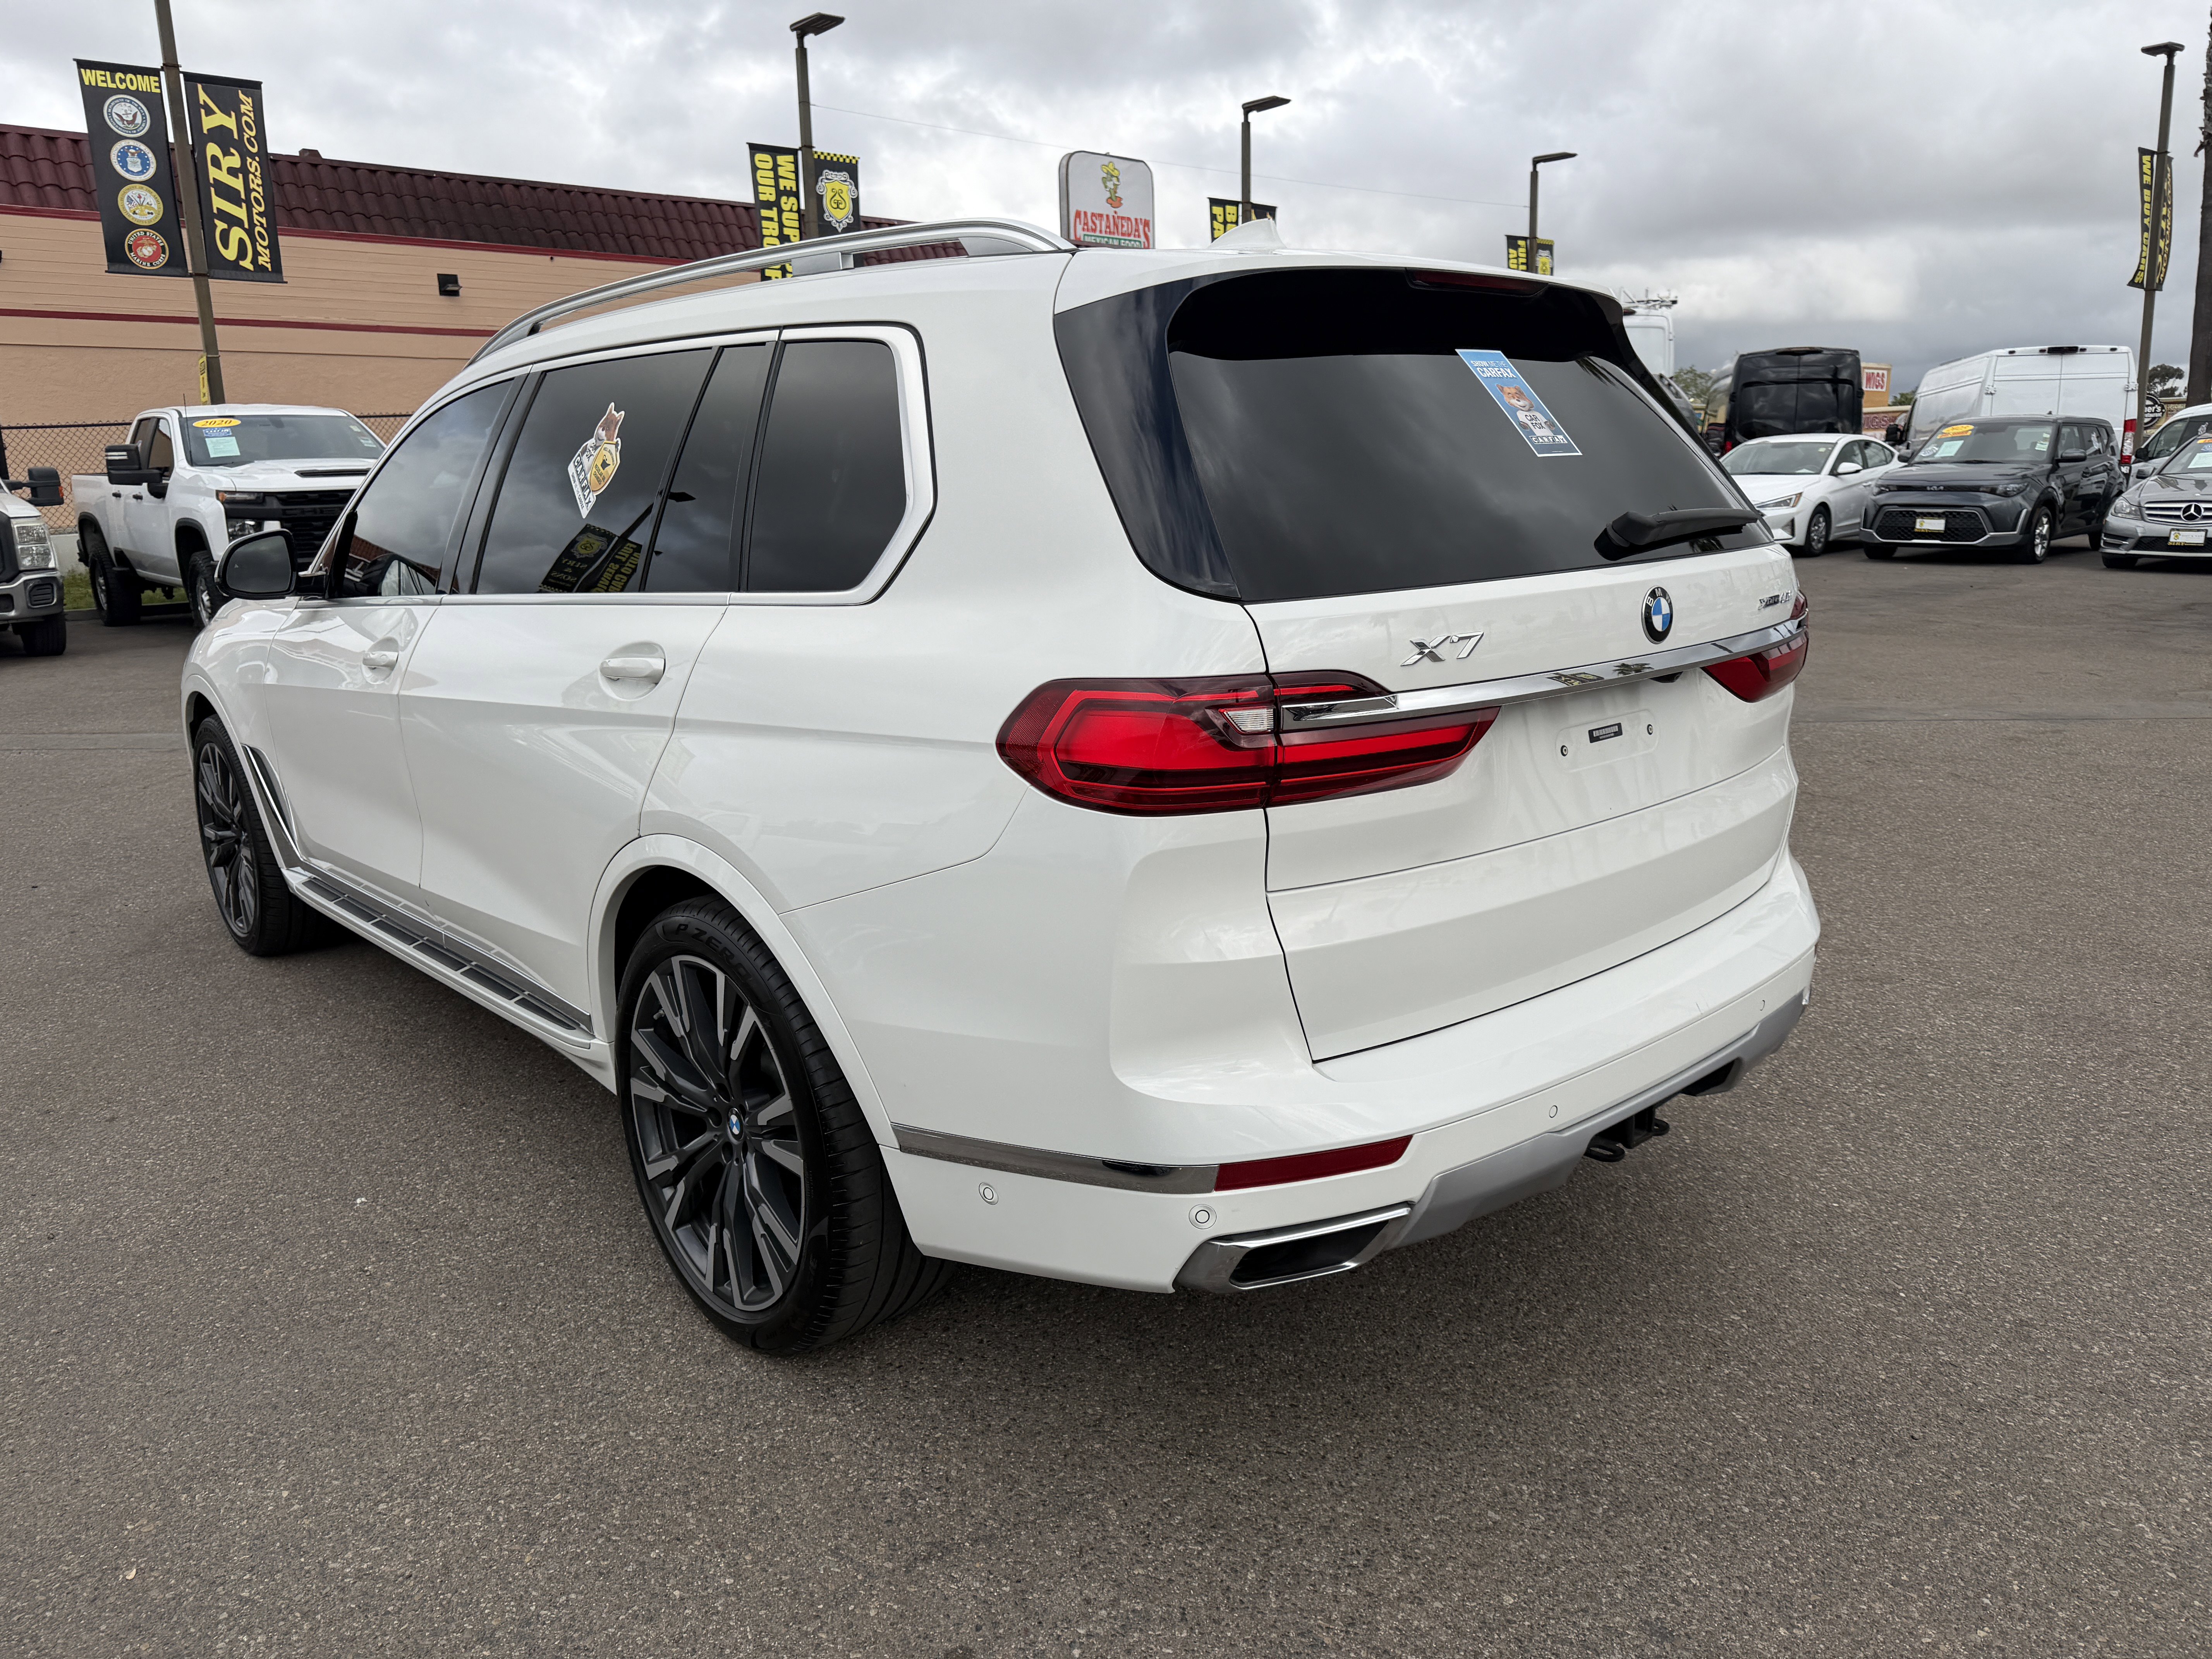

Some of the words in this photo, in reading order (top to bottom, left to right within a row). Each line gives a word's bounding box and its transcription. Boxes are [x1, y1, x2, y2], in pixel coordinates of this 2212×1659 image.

[80, 68, 161, 93] WELCOME
[197, 84, 254, 271] SIRY
[239, 90, 271, 271] MOTORS.COM
[754, 153, 776, 202] OUR
[776, 155, 797, 191] WE
[2142, 155, 2151, 185] WE
[2143, 189, 2151, 228] BUY
[128, 231, 144, 244] UNITED
[130, 252, 151, 267] MARINE
[1477, 367, 1517, 378] CARFAX
[1865, 372, 1885, 389] WIGS
[575, 456, 591, 508] CARFAX
[1400, 631, 1484, 666] X7
